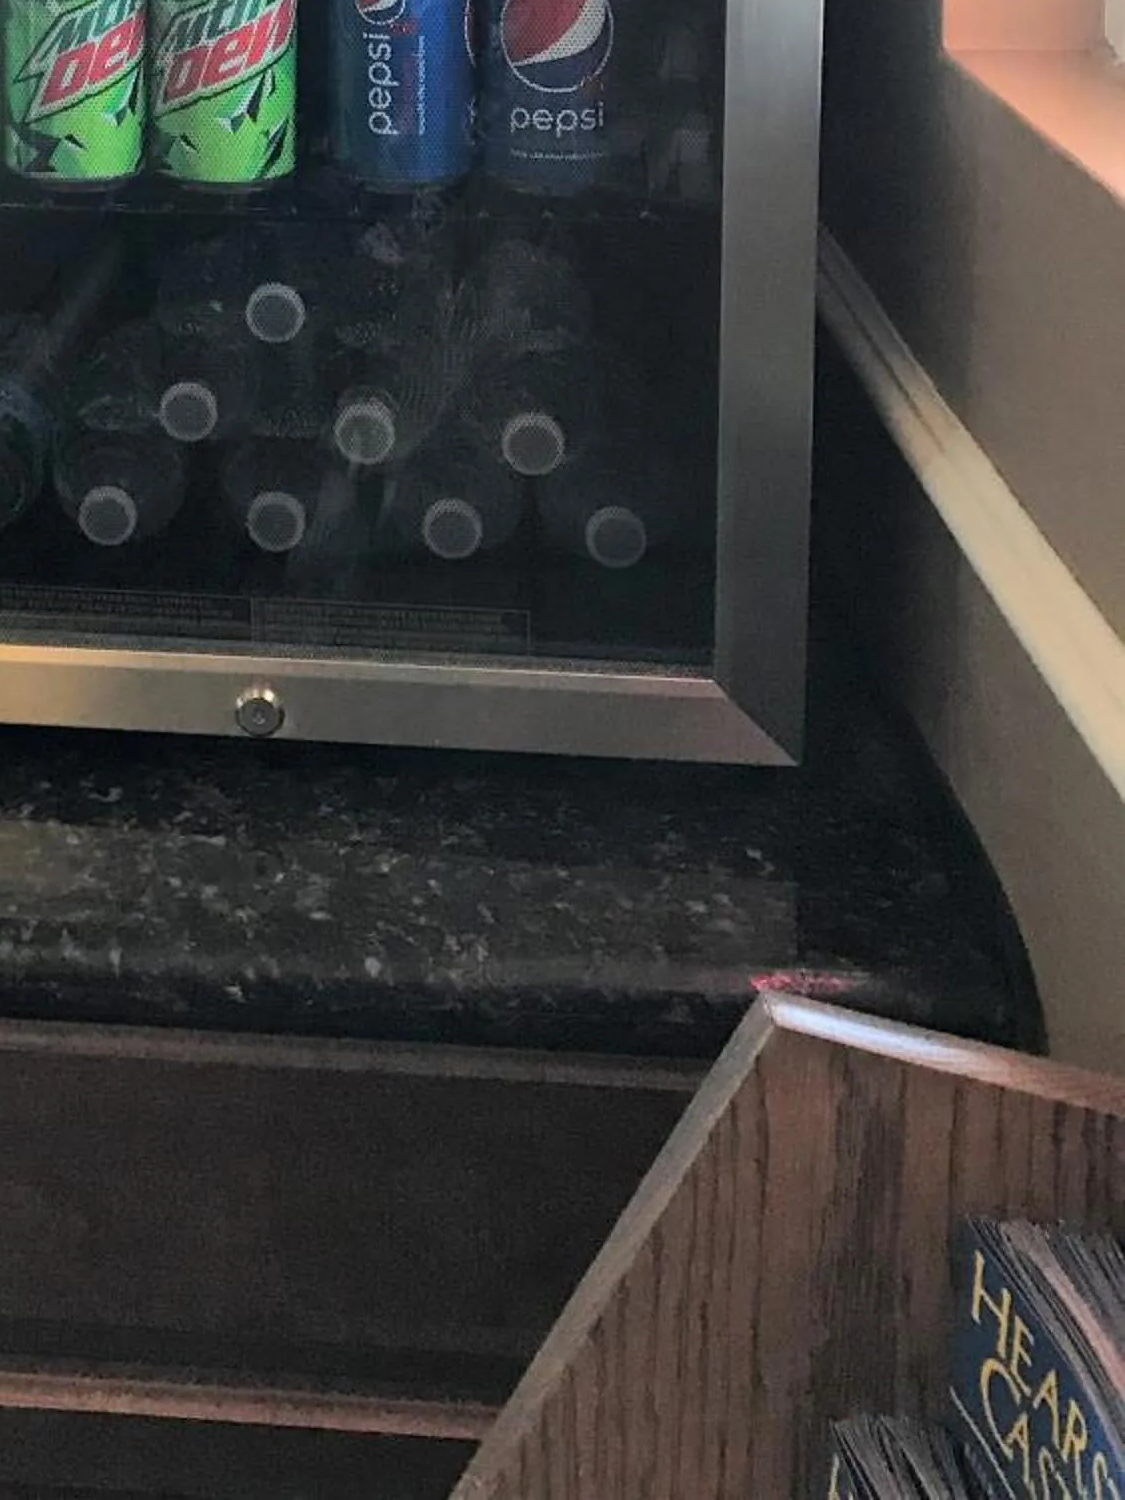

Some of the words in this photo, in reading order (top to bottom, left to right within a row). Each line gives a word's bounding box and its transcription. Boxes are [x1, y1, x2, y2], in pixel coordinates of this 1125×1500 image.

[40, 10, 143, 106] De
[363, 33, 399, 135] pepsi
[510, 102, 604, 137] pepsi
